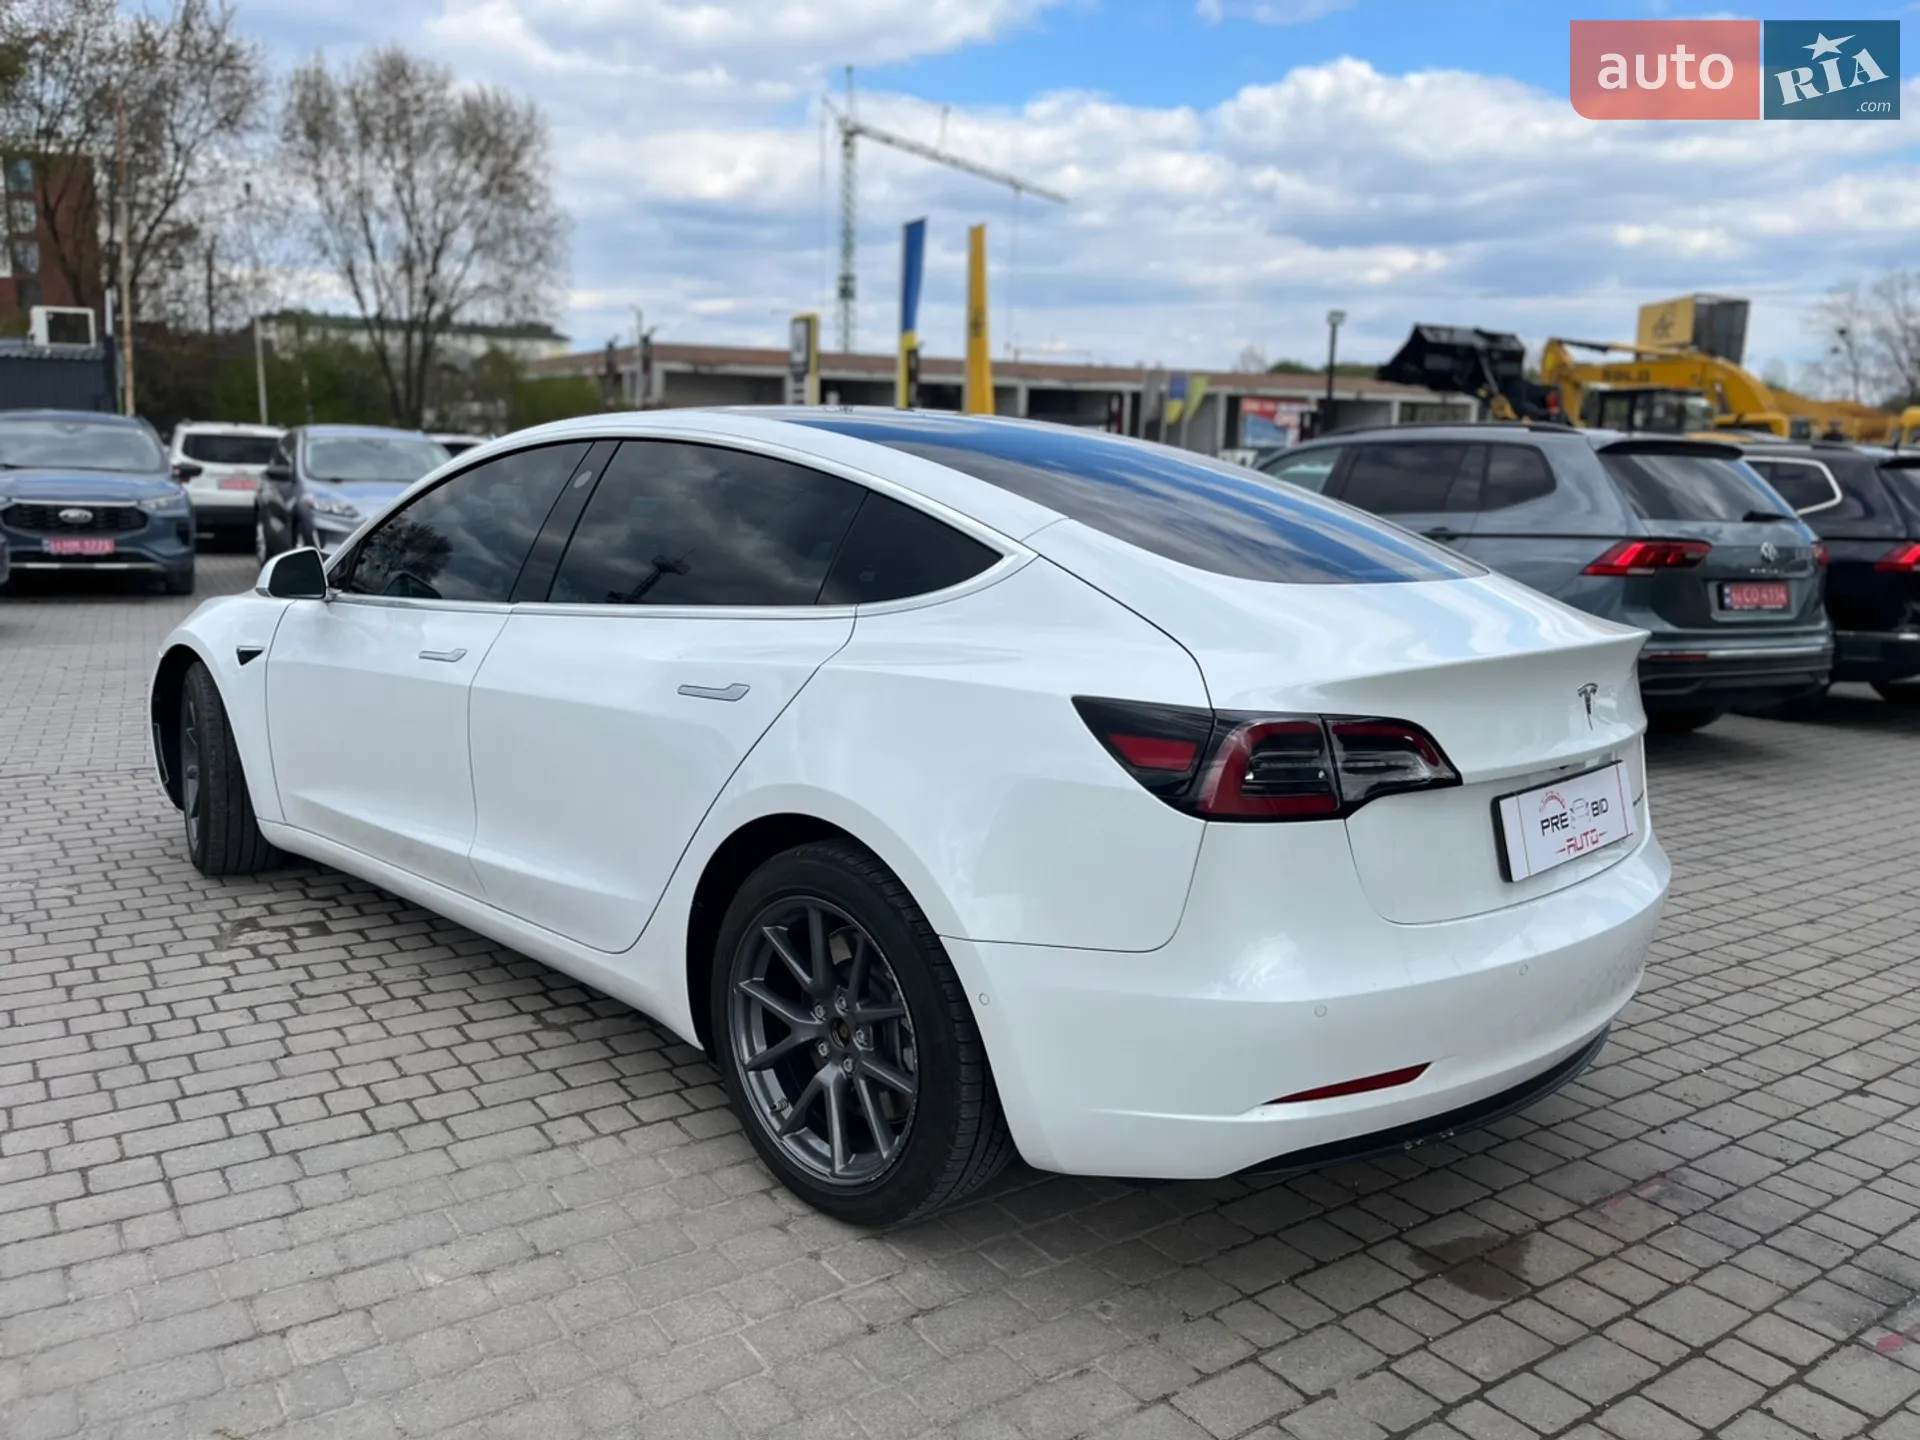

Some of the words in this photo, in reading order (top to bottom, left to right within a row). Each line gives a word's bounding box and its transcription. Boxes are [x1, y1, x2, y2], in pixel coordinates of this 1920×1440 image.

[1540, 811, 1570, 837] PRE
[1591, 798, 1609, 817] BID
[1565, 828, 1600, 855] AUTO
